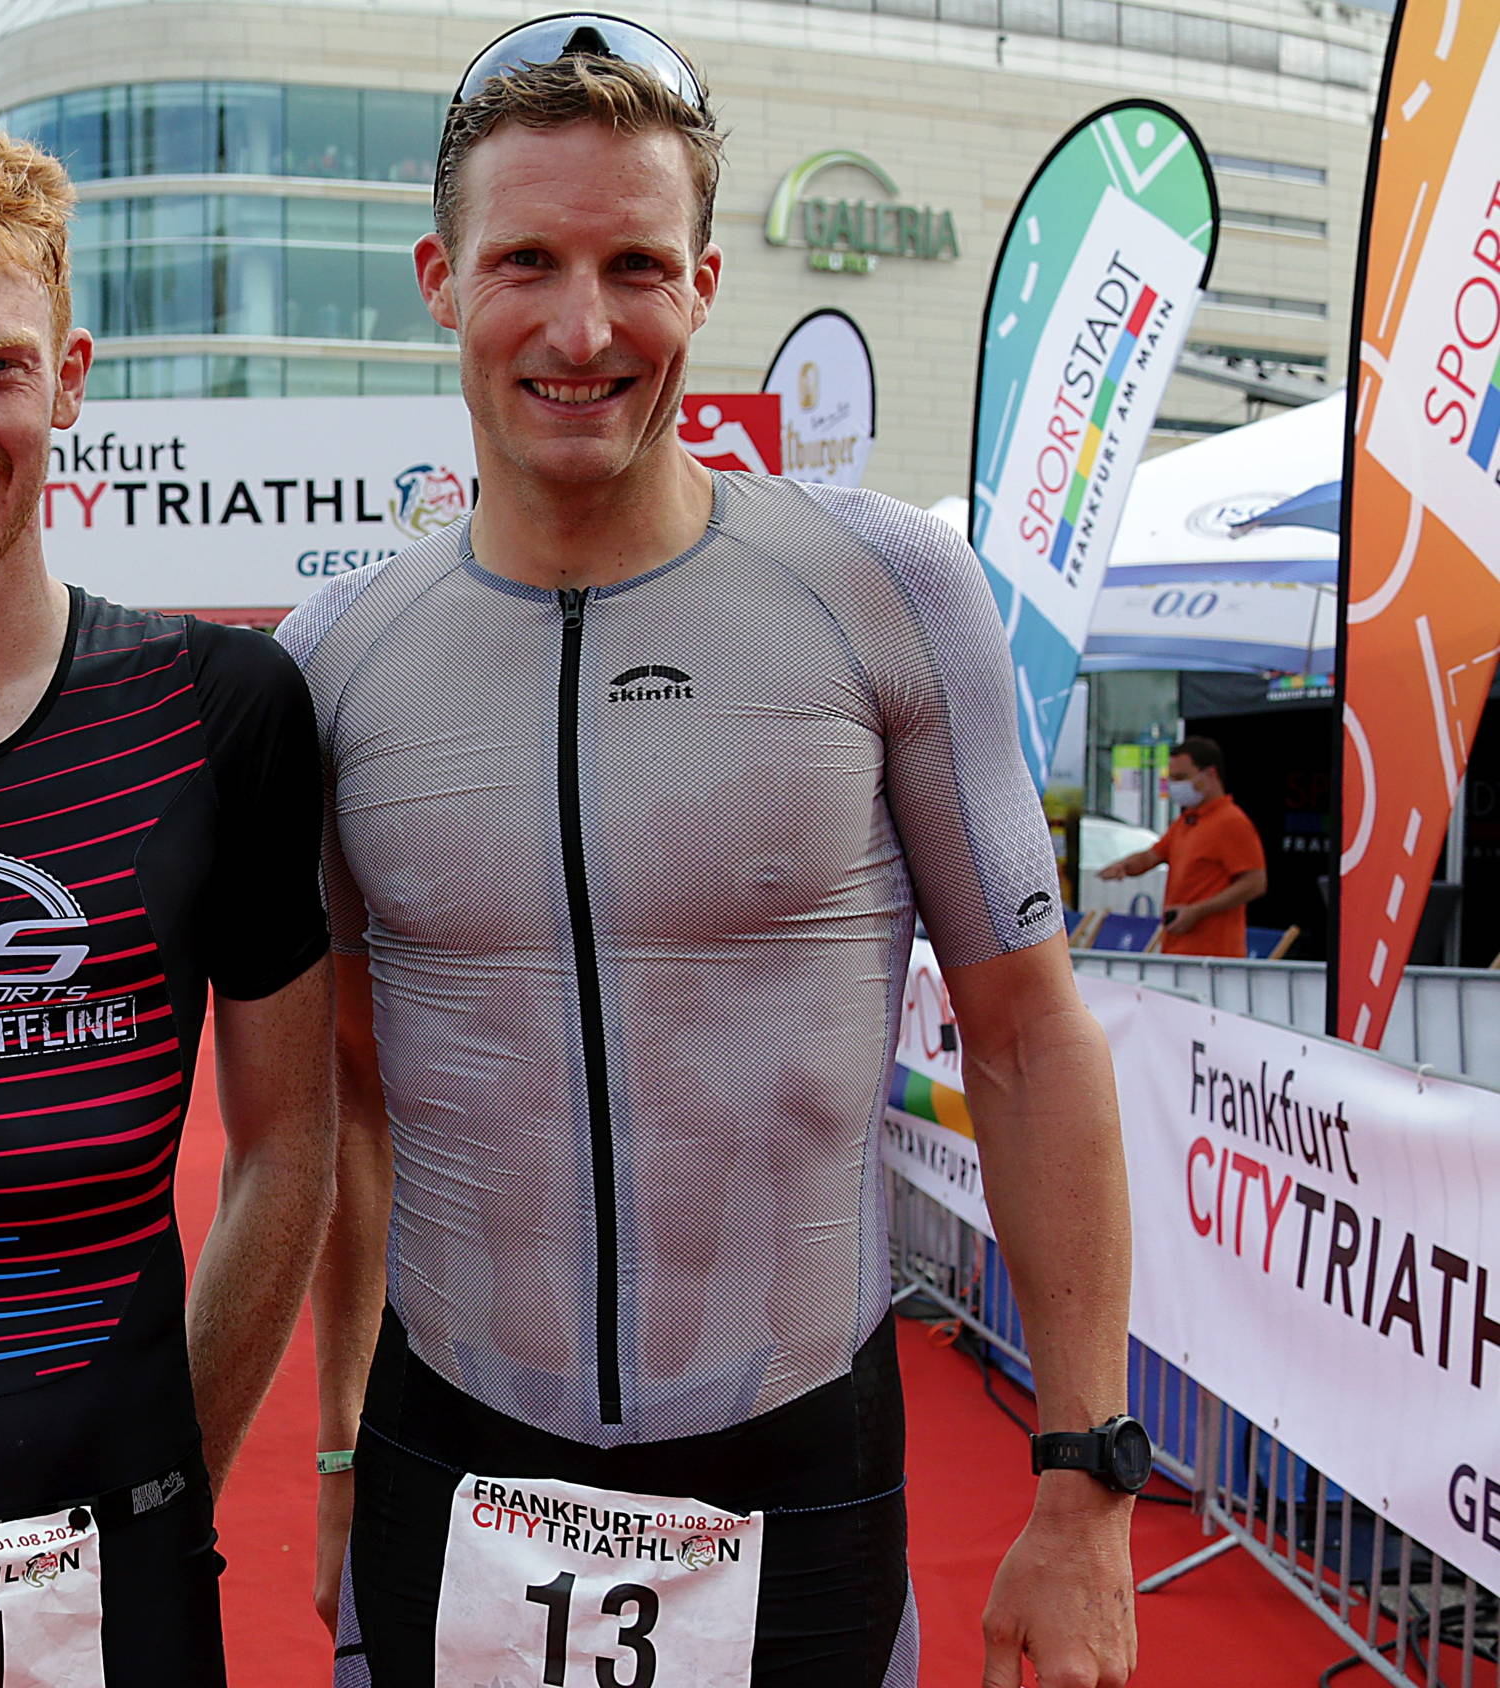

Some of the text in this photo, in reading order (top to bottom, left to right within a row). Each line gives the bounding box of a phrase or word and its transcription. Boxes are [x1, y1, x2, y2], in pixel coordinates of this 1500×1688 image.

[804, 198, 960, 259] GALERIA
[1019, 250, 1141, 555] SPORTSTADT
[1066, 299, 1175, 589] FRANKFURT AM MAIN
[49, 433, 186, 472] nkfurt
[608, 685, 694, 703] skinfit
[1190, 1038, 1359, 1185] Frankfurt
[473, 1478, 654, 1536] FRANKFURT
[525, 1571, 661, 1688] 13
